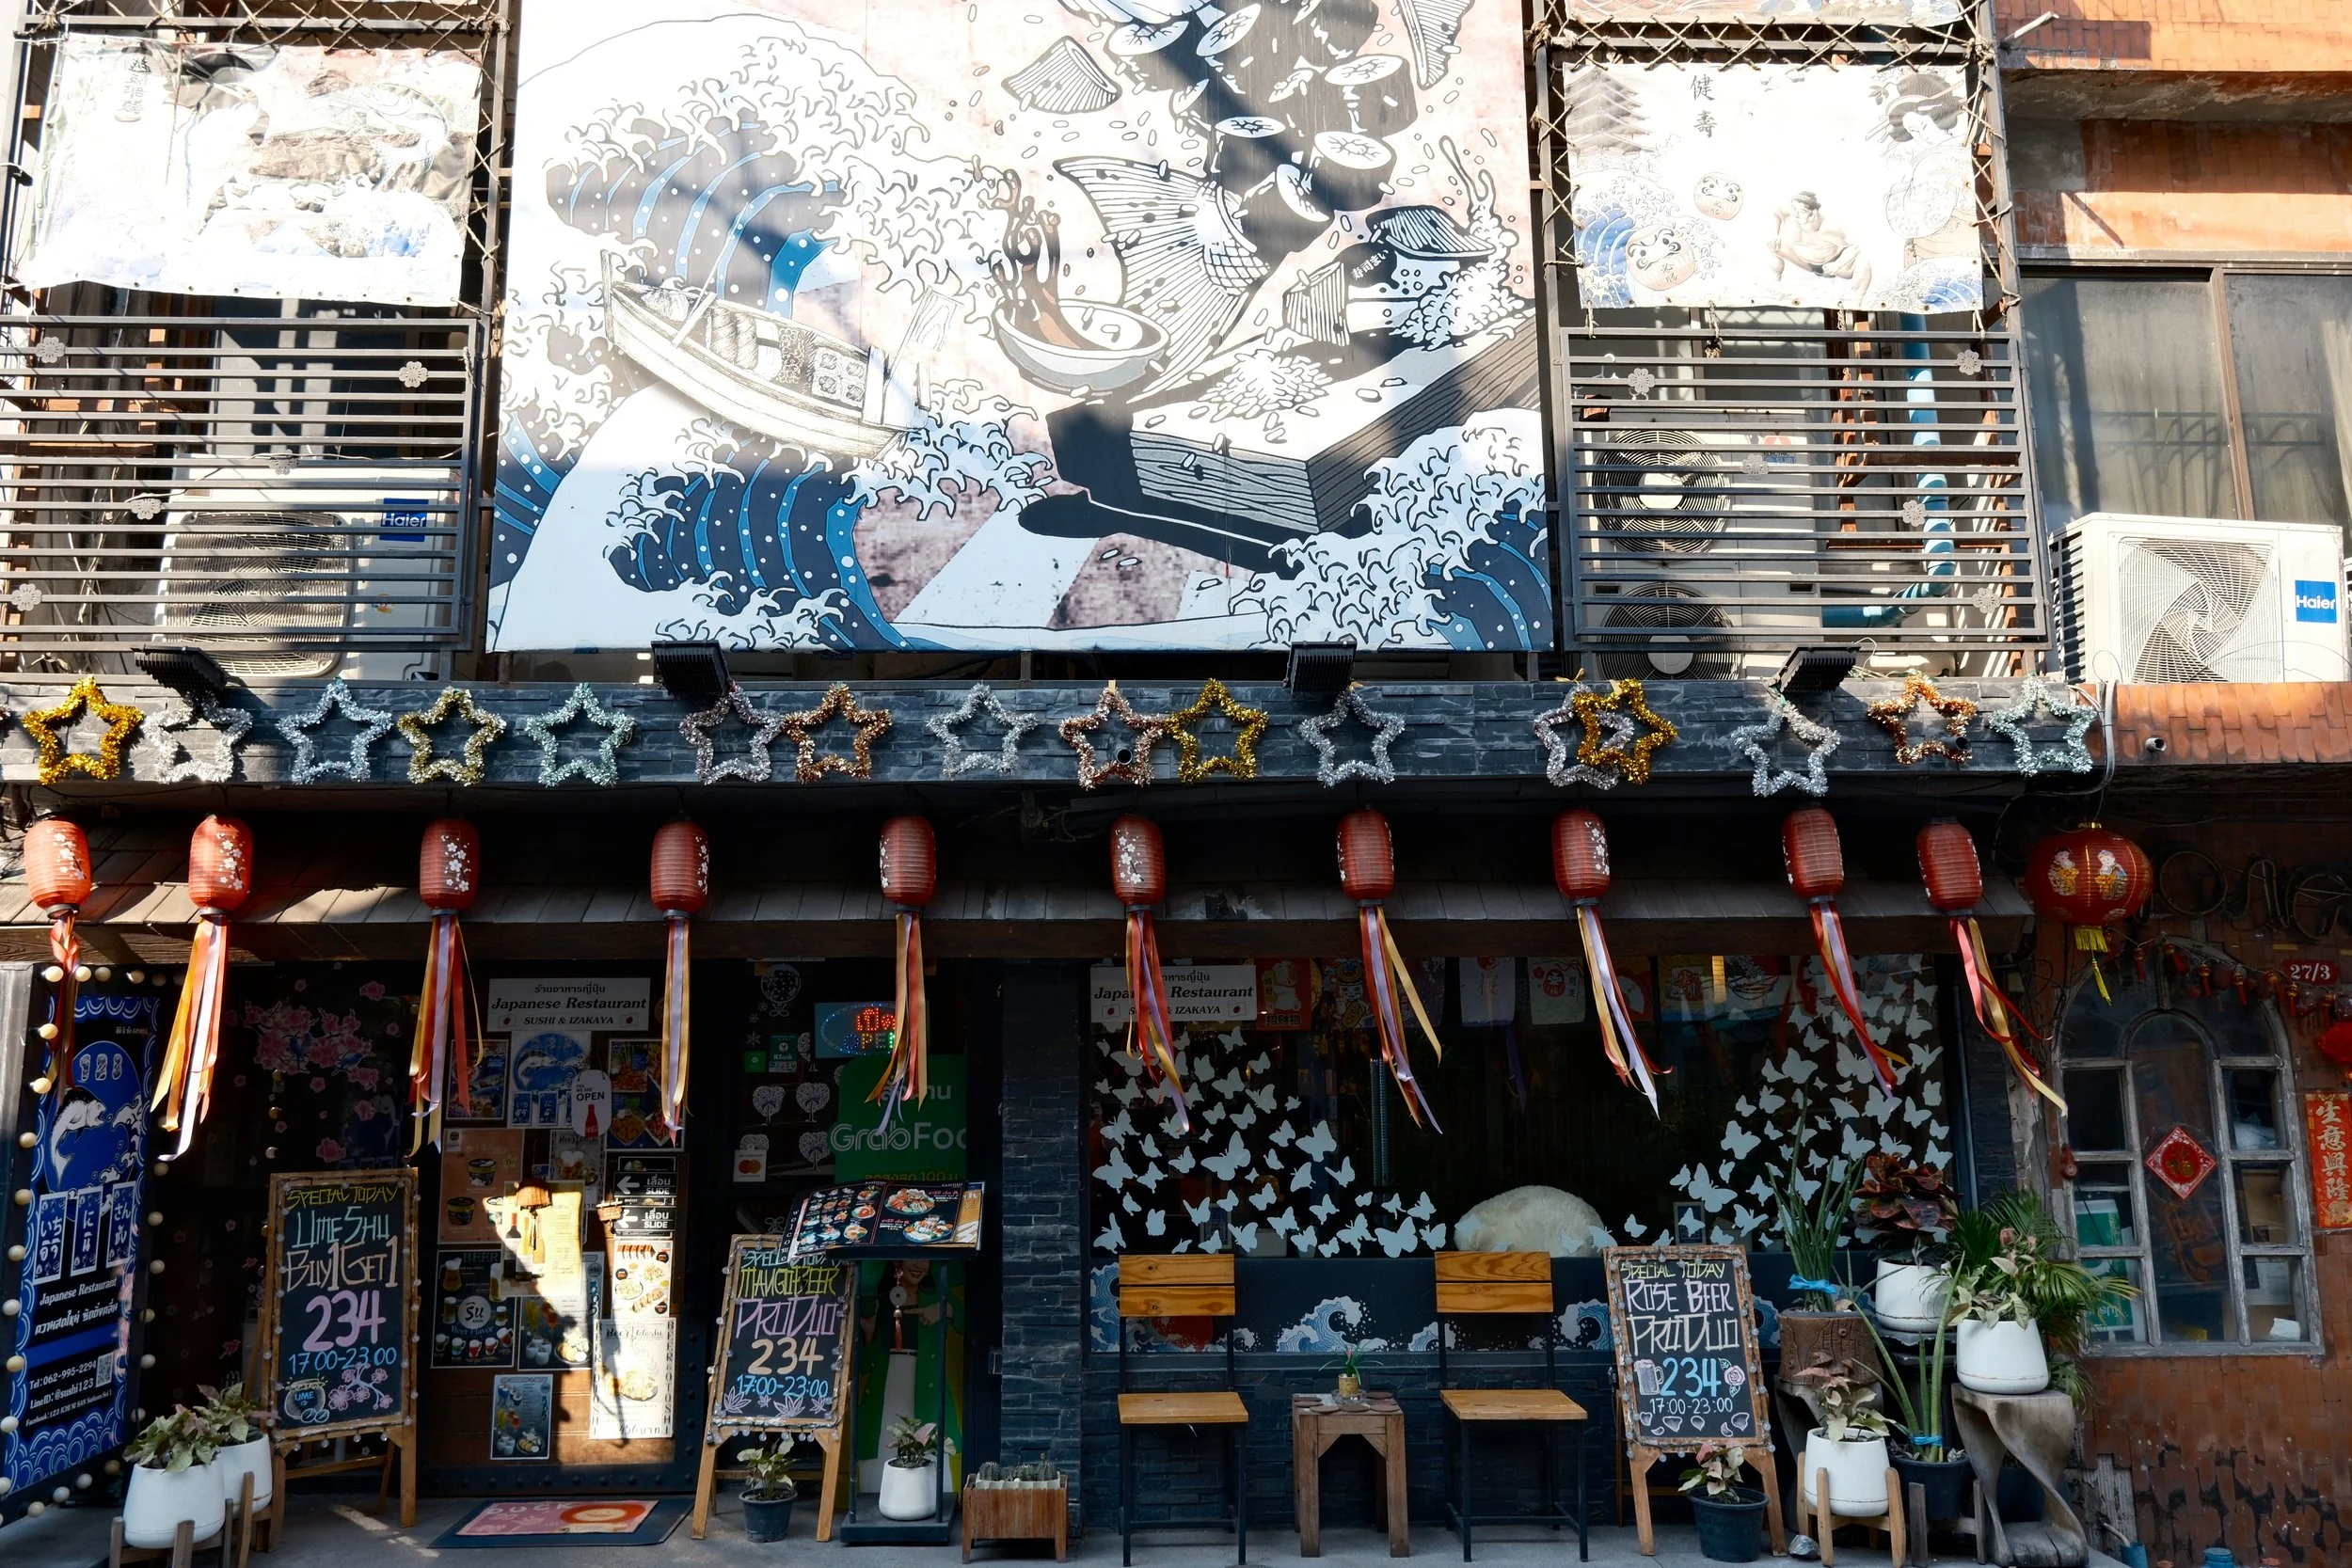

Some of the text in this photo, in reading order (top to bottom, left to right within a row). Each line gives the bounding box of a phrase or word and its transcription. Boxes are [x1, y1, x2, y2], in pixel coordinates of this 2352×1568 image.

[382, 512, 426, 527] Haier
[2296, 594, 2336, 610] Haier
[2290, 962, 2331, 981] 27/3
[534, 981, 606, 995] ร้านอาหารญี่ปุ่น
[1170, 986, 1254, 998] Restaurant
[491, 997, 646, 1011] Japanese Restaurant
[523, 1016, 613, 1025] SUSHI & IZAKAYA
[577, 1092, 605, 1101] OPEN
[2315, 1101, 2350, 1200] 生意興隆
[646, 1174, 671, 1186] เลื่อน
[350, 1185, 398, 1204] TODAY
[113, 1202, 132, 1222] さん
[644, 1207, 670, 1220] เลื่อน
[40, 1216, 62, 1238] いち
[1620, 1261, 1725, 1280] SPECIAL TODAY
[40, 1277, 118, 1307] Japanese Restaurant
[1685, 1279, 1735, 1313] BEER
[34, 1308, 81, 1336] ความสดใหม่
[302, 1290, 387, 1353] 234
[452, 1325, 494, 1336] Beer Flavor
[748, 1337, 825, 1375] 234
[1660, 1357, 1722, 1397] 234
[294, 1391, 314, 1402] UME
[1650, 1397, 1733, 1415] 17:00-23:00
